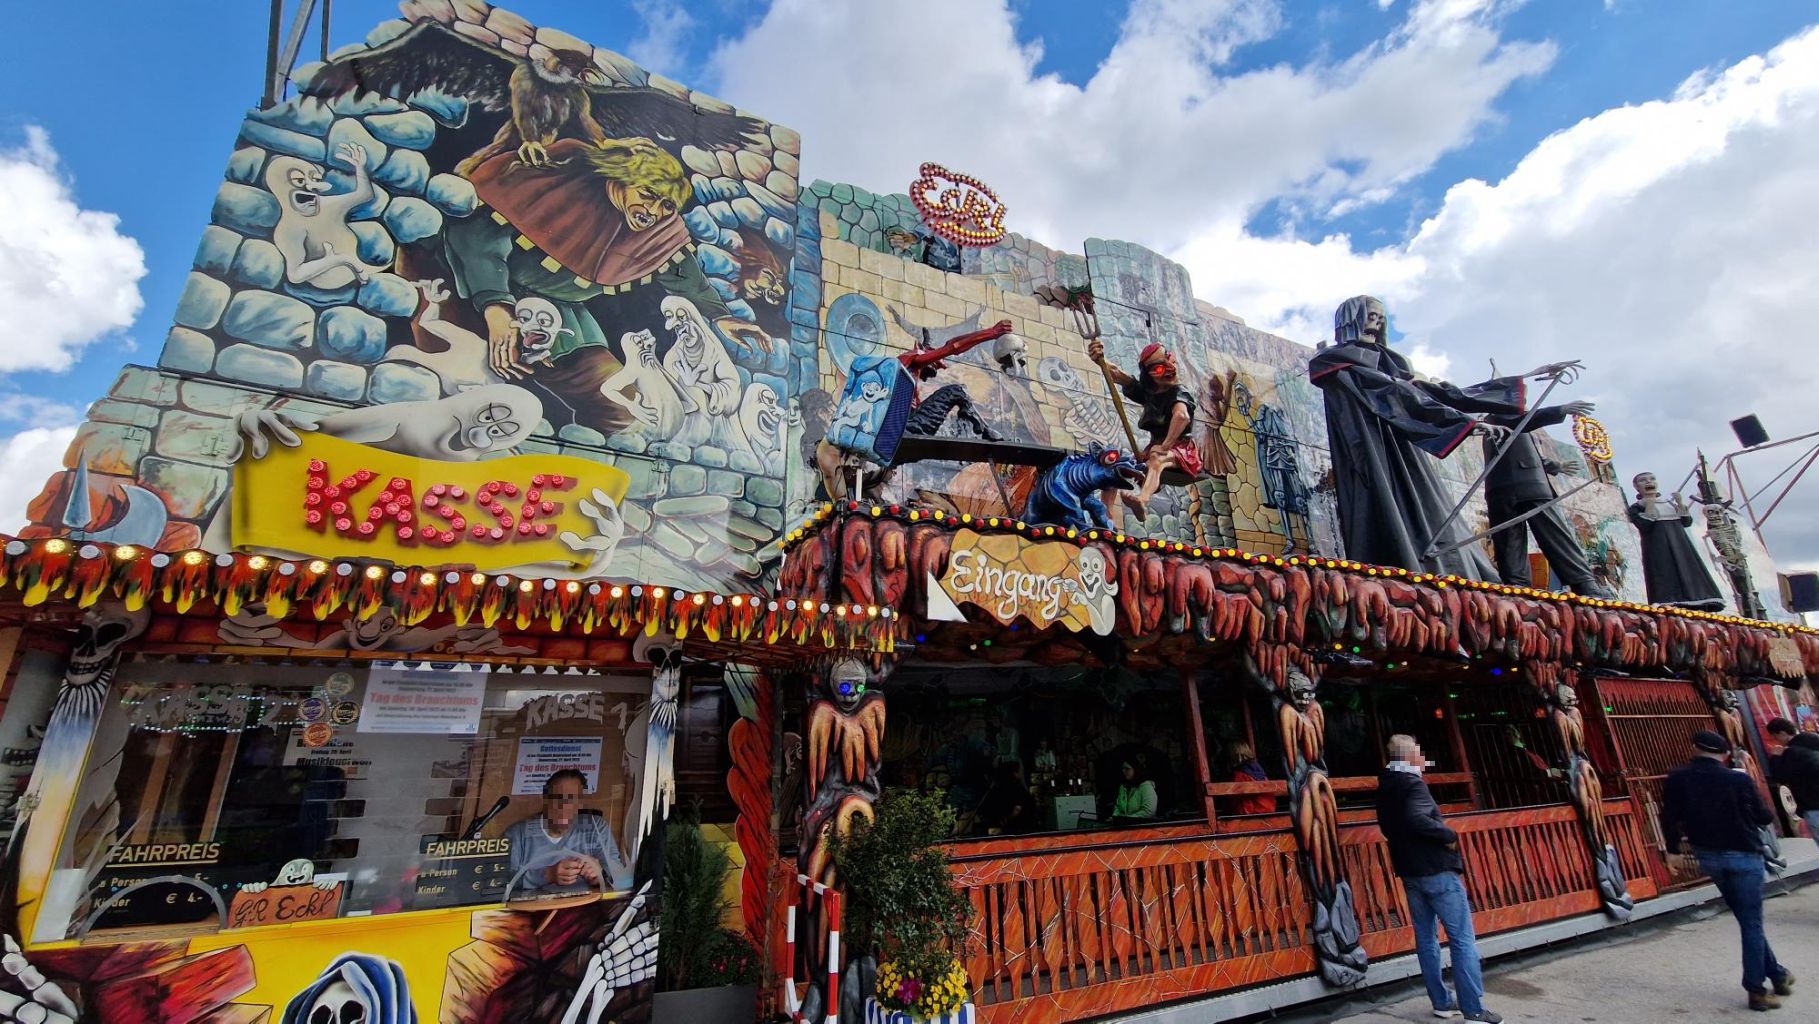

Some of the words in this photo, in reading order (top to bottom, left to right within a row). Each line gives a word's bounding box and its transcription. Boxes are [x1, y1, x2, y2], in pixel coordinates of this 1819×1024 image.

[303, 458, 578, 549] KASSE
[950, 549, 1062, 620] Eingang
[525, 692, 605, 734] KASSE
[611, 702, 628, 736] 1
[520, 764, 534, 773] Tag
[108, 843, 220, 863] FAHRPREIS
[426, 838, 510, 856] FAHRPREIS
[429, 869, 458, 877] Person
[111, 877, 147, 888] Perso
[417, 885, 446, 895] Kinder
[93, 898, 131, 908] Kider
[275, 891, 335, 920] Eckl
